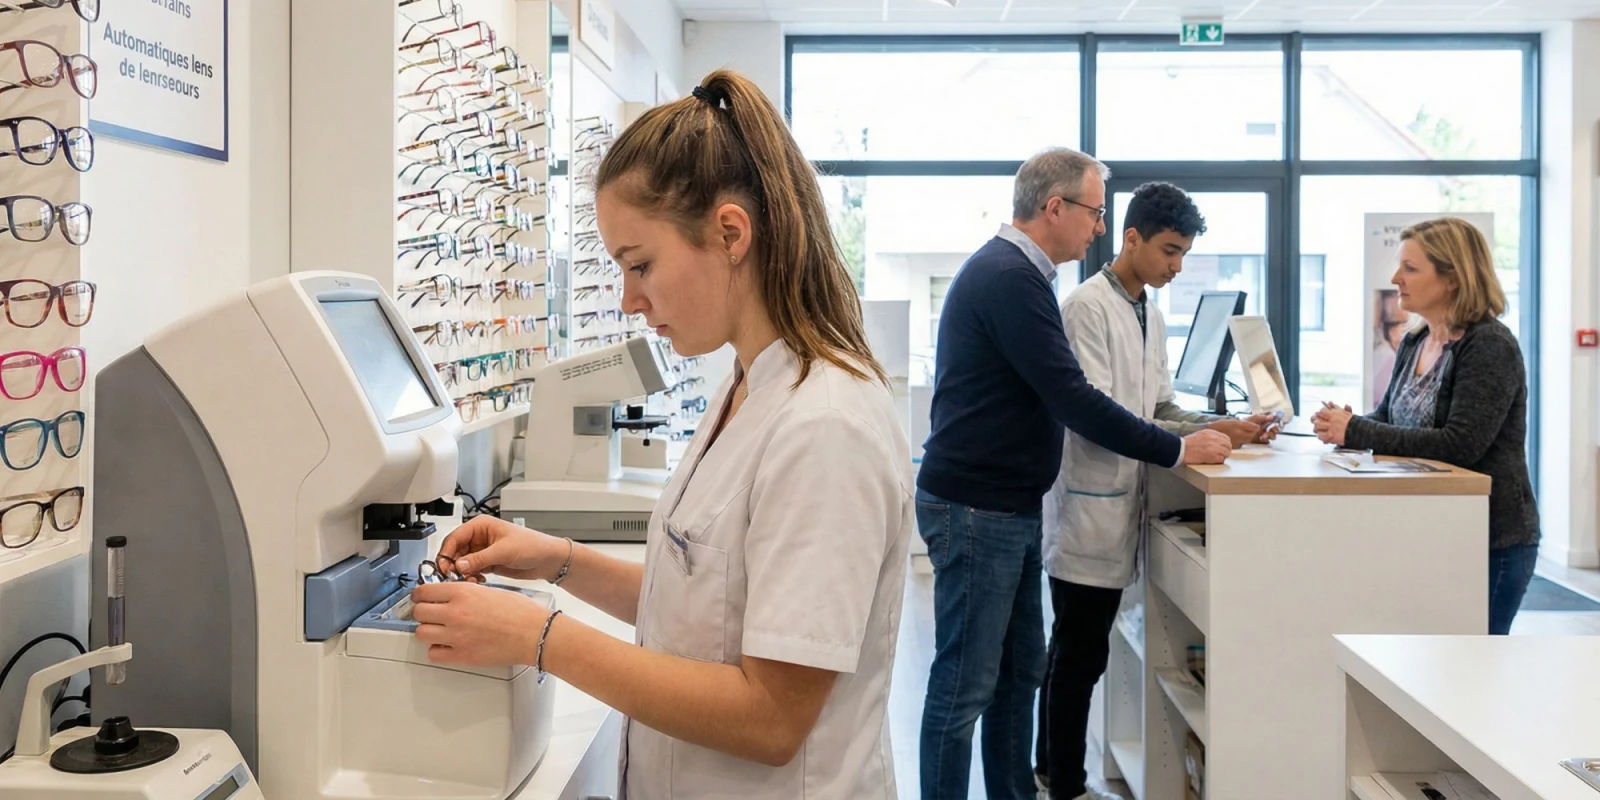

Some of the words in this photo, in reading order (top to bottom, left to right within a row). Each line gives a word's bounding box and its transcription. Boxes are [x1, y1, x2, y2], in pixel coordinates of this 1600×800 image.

[103, 22, 189, 70] Automatiques
[192, 54, 213, 78] lens
[119, 58, 136, 79] de
[139, 63, 200, 99] lenrseours
